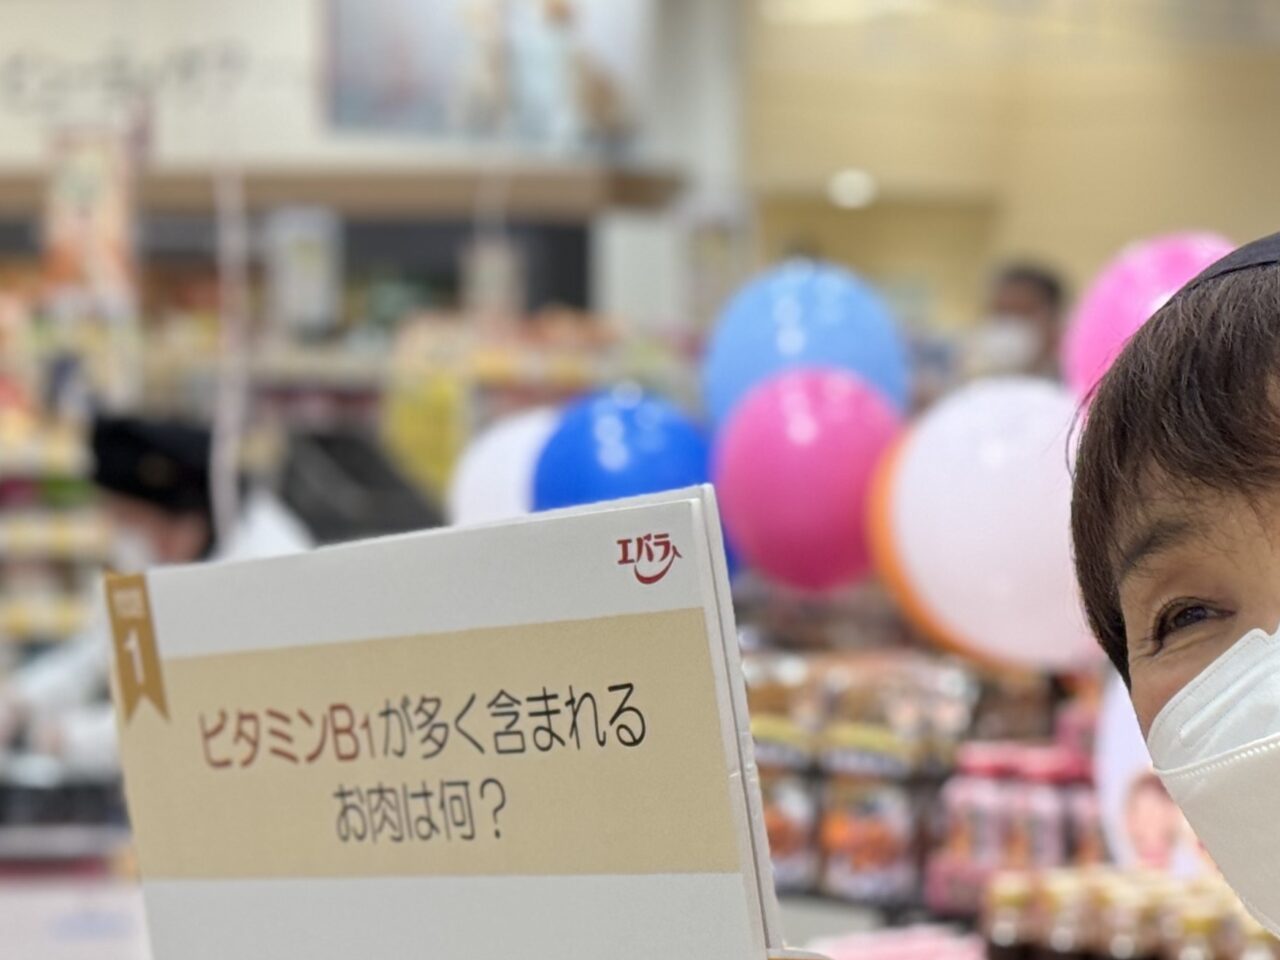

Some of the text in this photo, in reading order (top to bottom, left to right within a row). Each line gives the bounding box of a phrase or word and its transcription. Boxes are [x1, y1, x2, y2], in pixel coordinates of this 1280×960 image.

[616, 532, 672, 566] エバラ
[122, 626, 146, 686] 1
[331, 777, 506, 844] お肉は何？
